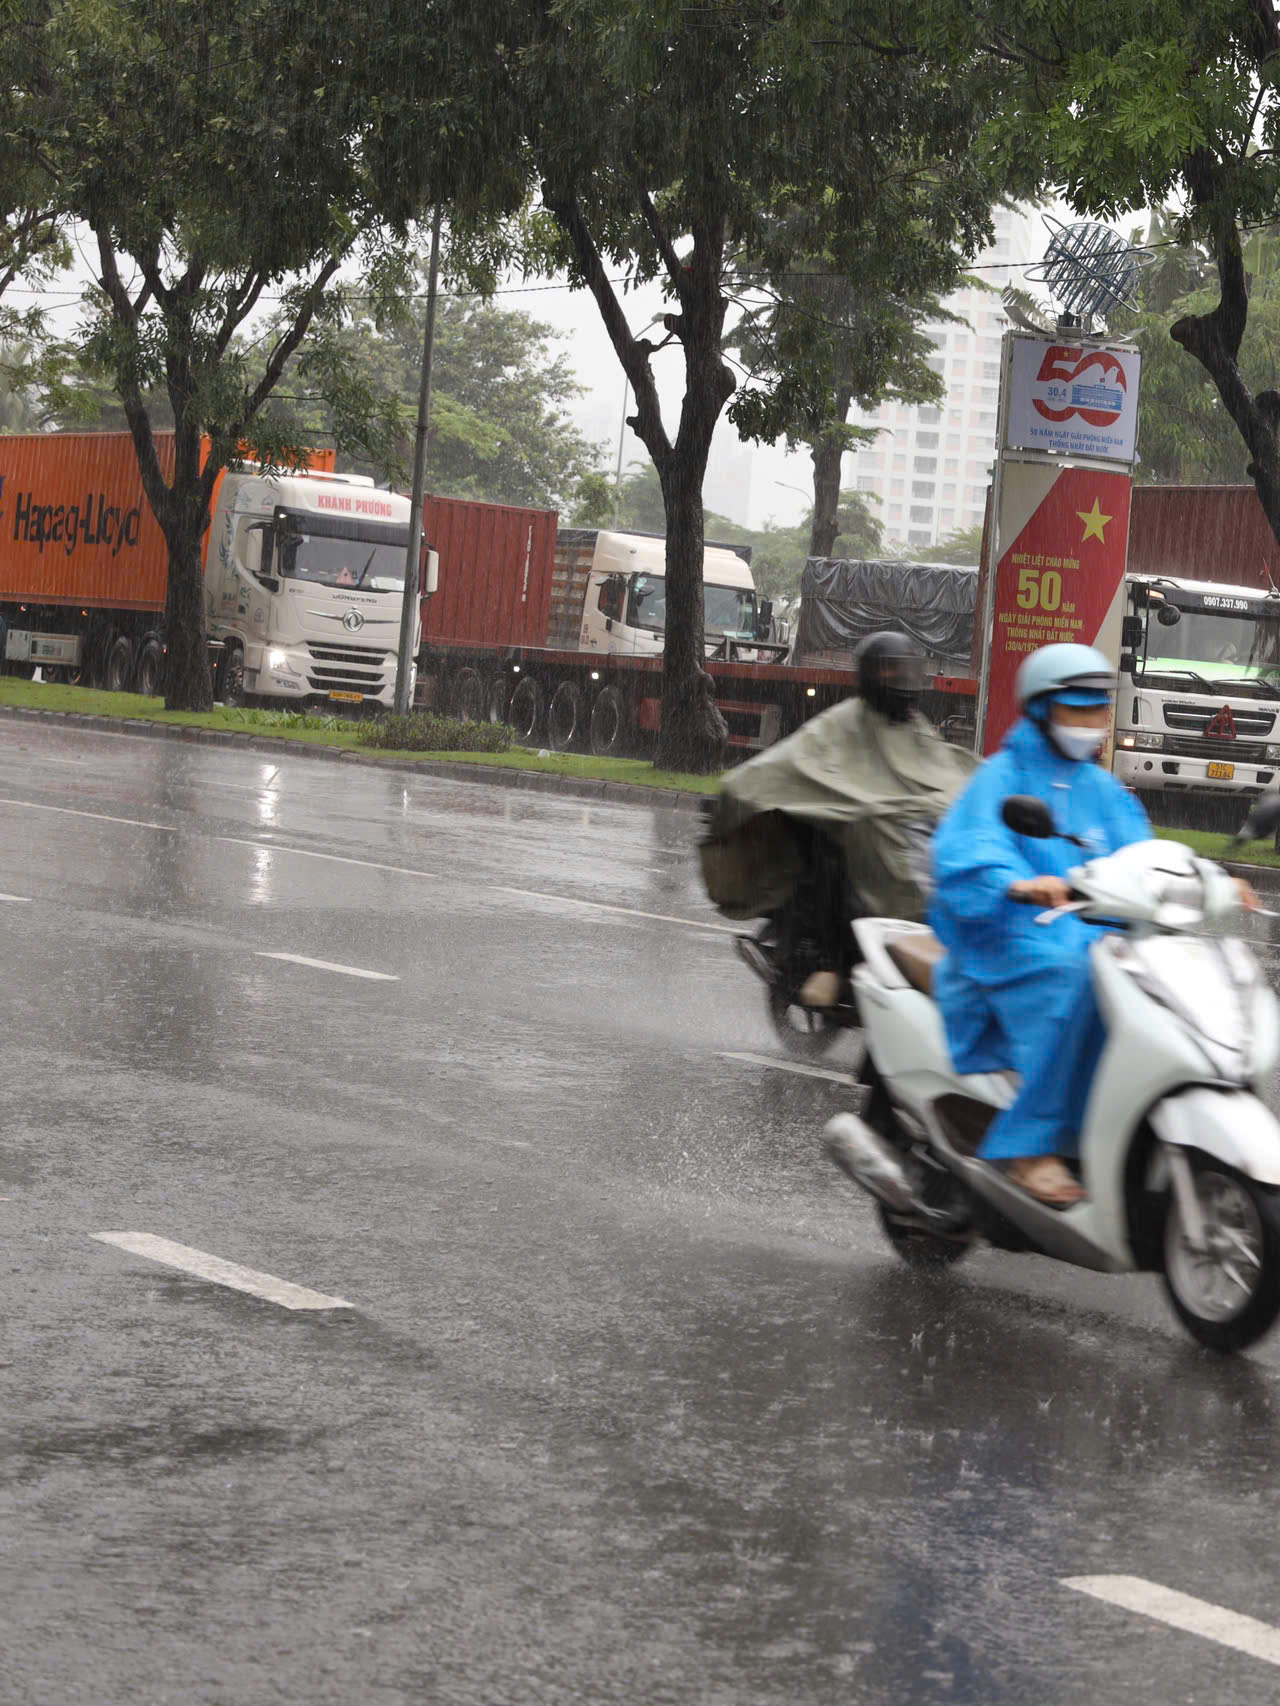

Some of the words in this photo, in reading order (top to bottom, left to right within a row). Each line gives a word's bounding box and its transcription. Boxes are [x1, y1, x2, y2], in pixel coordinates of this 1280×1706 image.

[1048, 386, 1066, 398] 30.4
[13, 491, 142, 558] Hapag-Lloyd
[1016, 568, 1062, 611] 50
[1204, 596, 1248, 610] 0907.337.990
